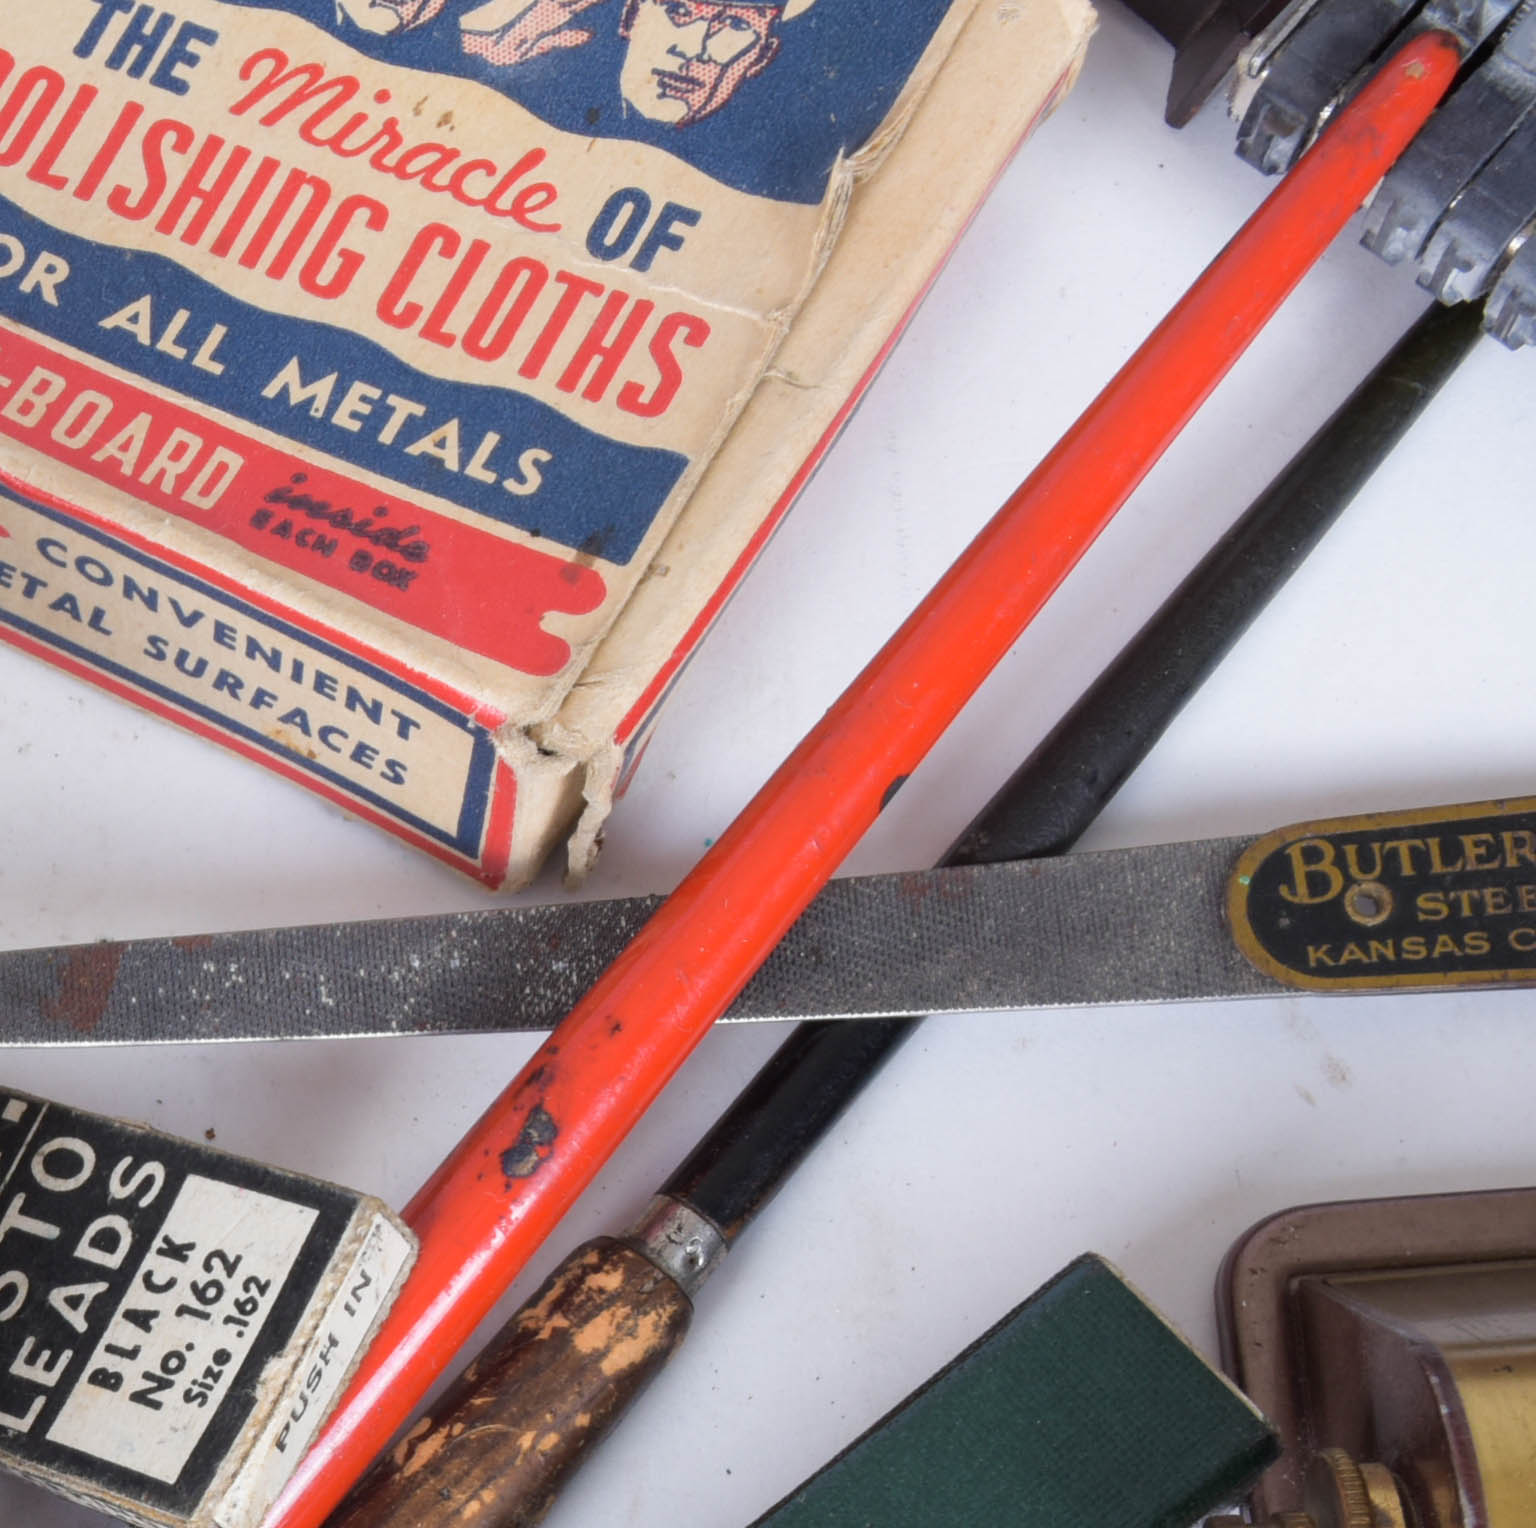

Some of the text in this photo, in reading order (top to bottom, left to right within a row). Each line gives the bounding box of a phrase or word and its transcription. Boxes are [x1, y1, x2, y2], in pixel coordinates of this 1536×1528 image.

[72, 0, 704, 273] THE Miracle OF
[98, 288, 229, 379] ALL
[262, 351, 555, 499] METALS
[376, 220, 711, 420] CLOTHS
[249, 508, 419, 592] EACH BOX
[264, 472, 431, 563] inside
[35, 534, 422, 743] CONVENIENT
[143, 632, 409, 787] SURFACES
[1307, 931, 1491, 968] KANSAS
[87, 1234, 196, 1394] BLACK
[128, 1248, 243, 1411] No. 162
[182, 1274, 272, 1408] Size .162
[275, 1269, 372, 1453] PUSH IN
